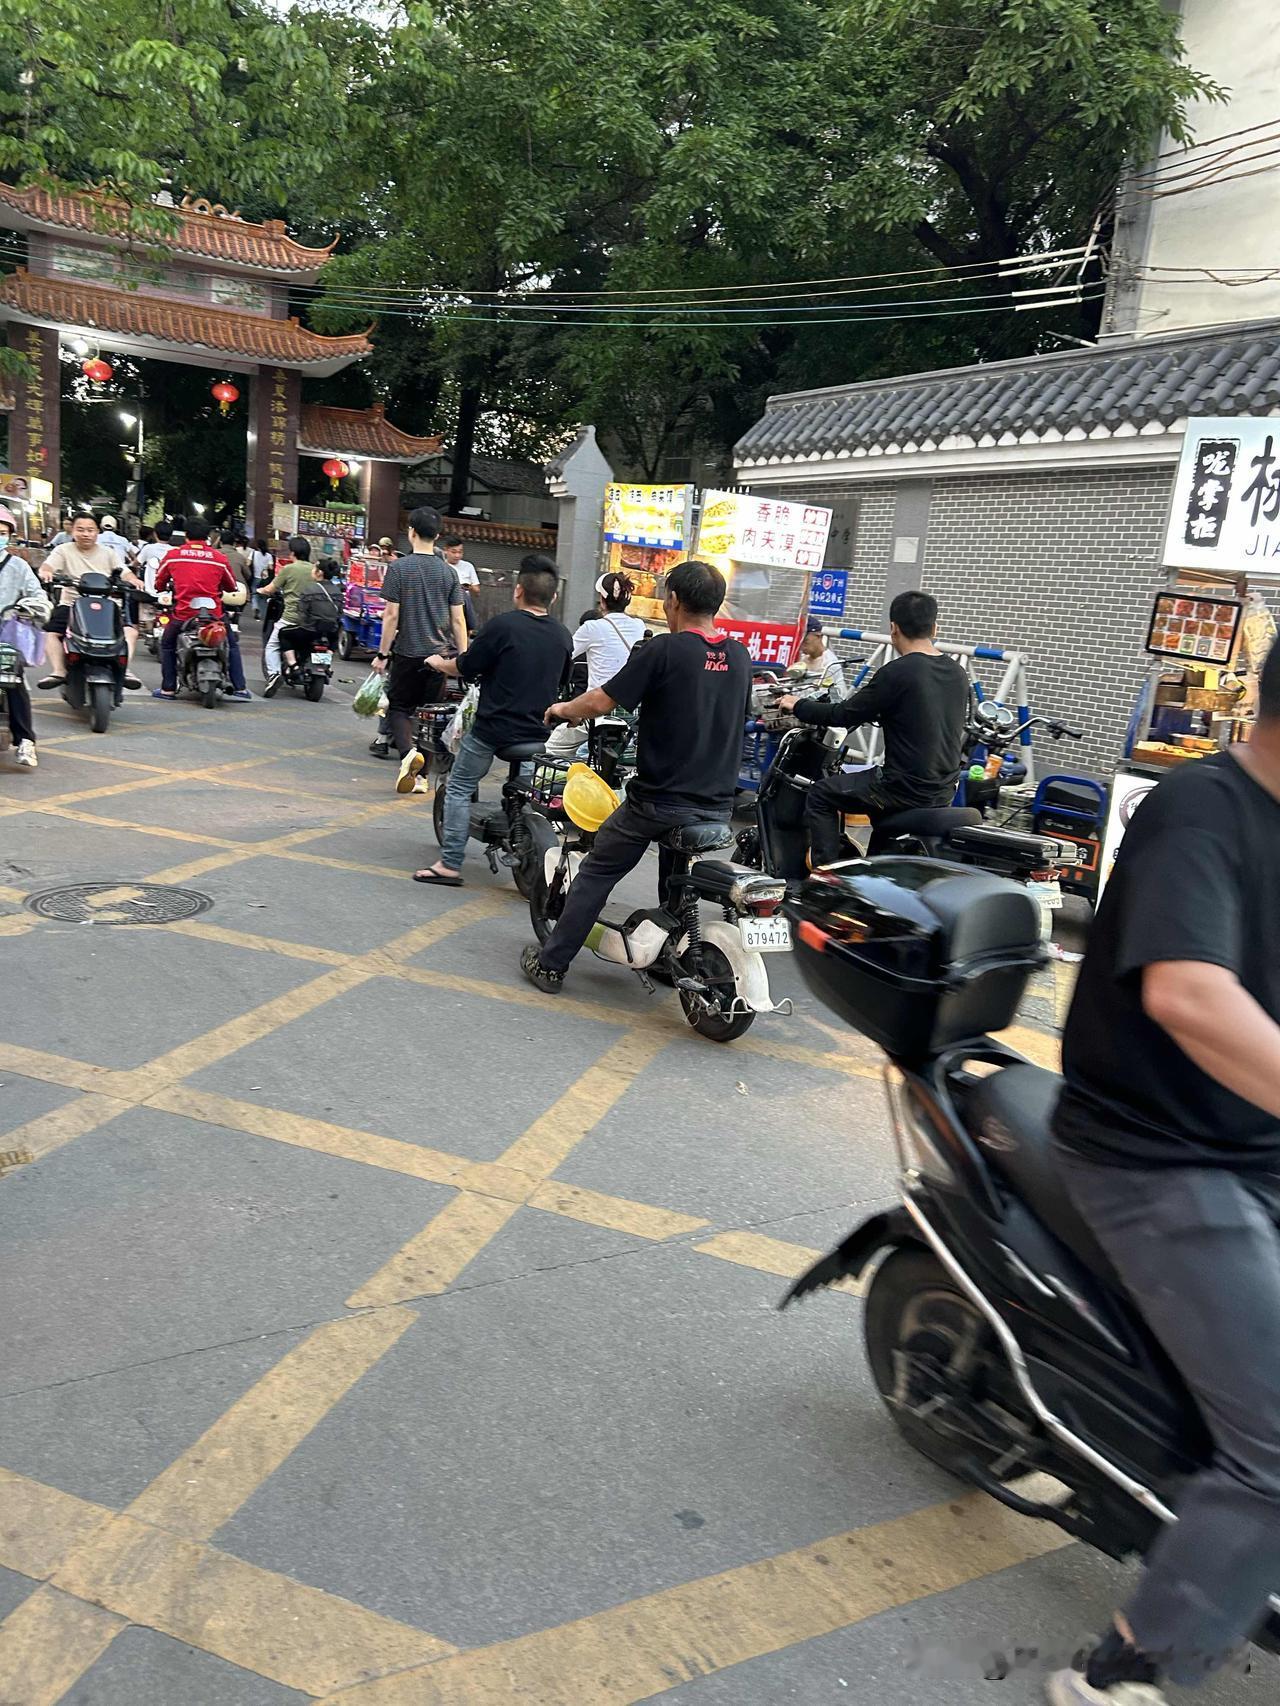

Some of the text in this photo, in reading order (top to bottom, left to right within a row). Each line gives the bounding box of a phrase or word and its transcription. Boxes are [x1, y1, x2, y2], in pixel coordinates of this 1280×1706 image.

[757, 502, 790, 526] 香脆
[742, 528, 795, 552] 肉夹馍
[748, 931, 788, 945] 879472
